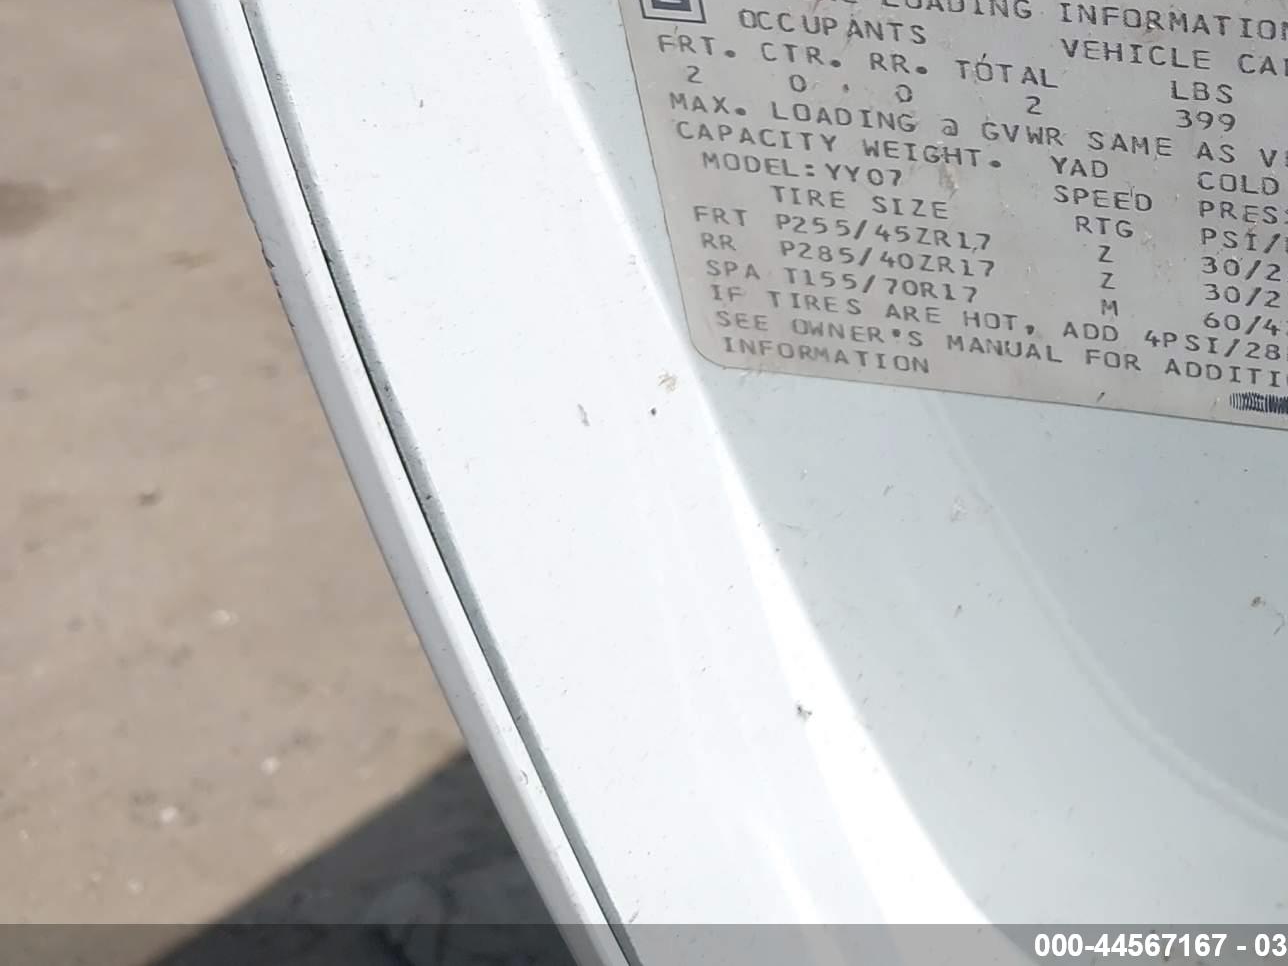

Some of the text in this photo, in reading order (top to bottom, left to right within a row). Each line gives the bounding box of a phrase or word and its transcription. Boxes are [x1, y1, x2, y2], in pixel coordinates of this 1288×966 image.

[739, 9, 926, 44] OCCUPANTS
[1061, 39, 1210, 69] VEHICLE
[658, 34, 736, 58] FRT.
[761, 42, 841, 67] CTR.
[870, 53, 928, 74] RR.
[955, 62, 1058, 89] TOTAL
[1171, 81, 1232, 104] LBS
[670, 92, 746, 116] MAX.
[772, 102, 917, 132] LOADING
[982, 122, 1063, 146] GVWR
[1088, 131, 1171, 156] SAME
[1197, 142, 1235, 163] AS
[687, 66, 702, 83] 2
[789, 75, 807, 93] 0
[896, 84, 912, 103] 0
[1026, 96, 1042, 115] 2
[1176, 110, 1235, 132] 399
[677, 121, 836, 152] CAPACITY
[863, 139, 1001, 168] WEIGHT.
[1051, 156, 1108, 178] YAD
[1198, 171, 1279, 195] COLD
[703, 152, 901, 186] MODEL:YY07
[1054, 185, 1152, 211] SPEED
[693, 206, 746, 226] FRT
[776, 214, 990, 253] P255/45ZR17
[1099, 245, 1113, 262] Z
[771, 186, 845, 208] TIRE
[872, 196, 948, 219] SIZE
[1075, 216, 1133, 238] RTG
[701, 233, 736, 251] RR
[780, 241, 994, 277] P285/40ZR17
[1101, 272, 1115, 289] Z
[706, 260, 760, 280] SPA
[784, 268, 977, 303] T155/70R17
[1102, 299, 1118, 316] M
[711, 284, 742, 302] IF
[768, 291, 861, 315] TIRES
[886, 304, 940, 323] ARE
[963, 311, 1034, 335] HOT,
[1063, 322, 1118, 341] ADD
[716, 311, 768, 331] SEE
[947, 335, 1062, 363] MANUAL
[1086, 349, 1141, 371] FOR
[723, 336, 929, 373] INFORMATION
